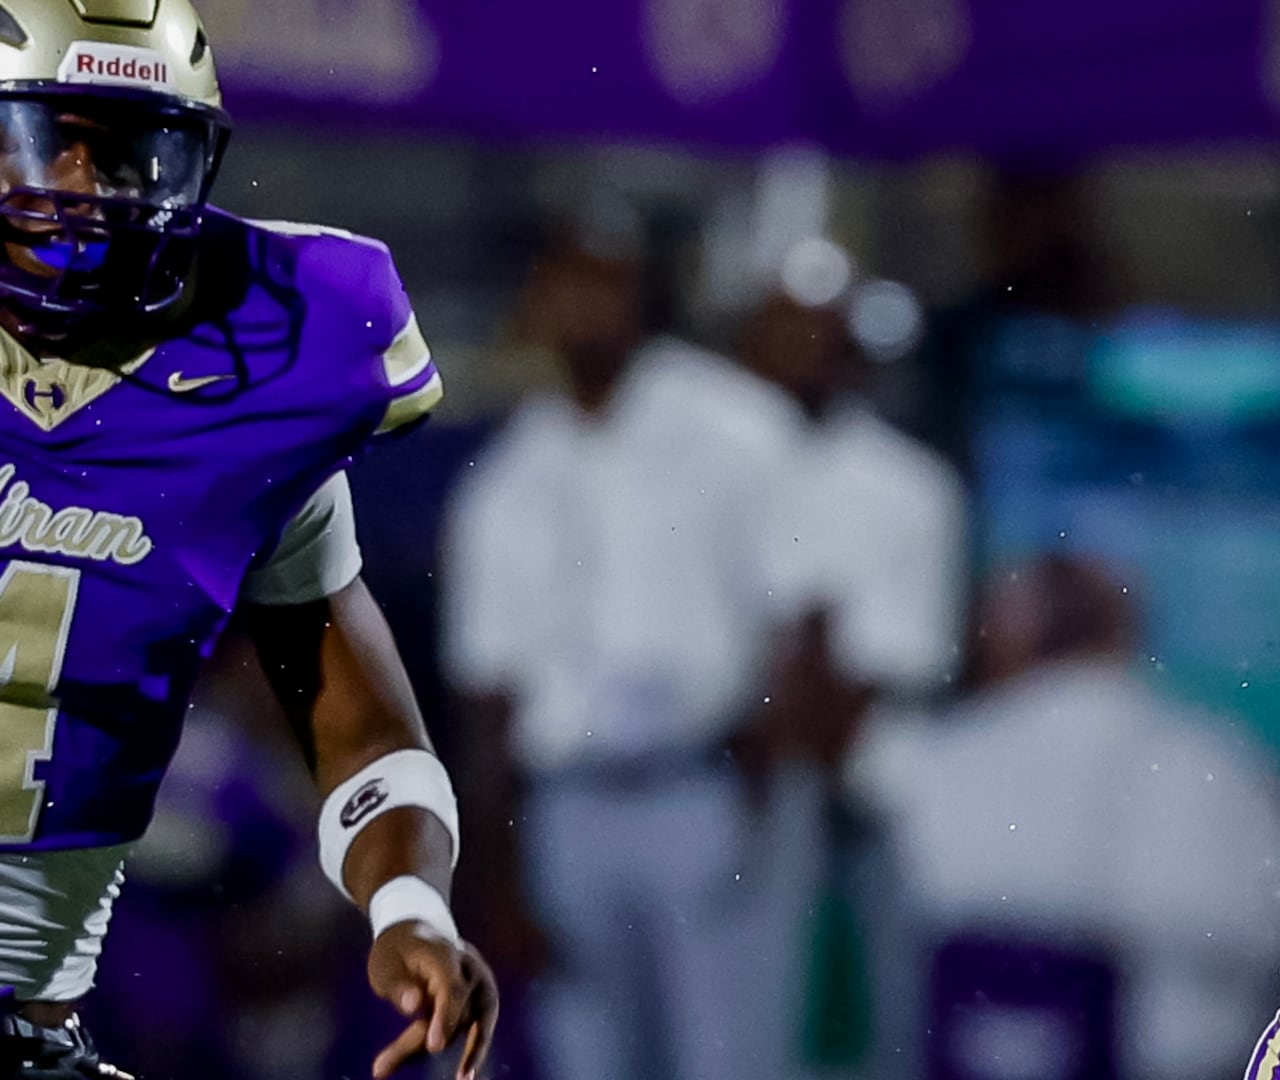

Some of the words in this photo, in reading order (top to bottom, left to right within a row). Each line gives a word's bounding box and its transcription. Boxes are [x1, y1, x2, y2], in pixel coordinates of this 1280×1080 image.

[77, 53, 167, 83] Riddell
[0, 462, 153, 566] iram
[0, 559, 81, 846] 4
